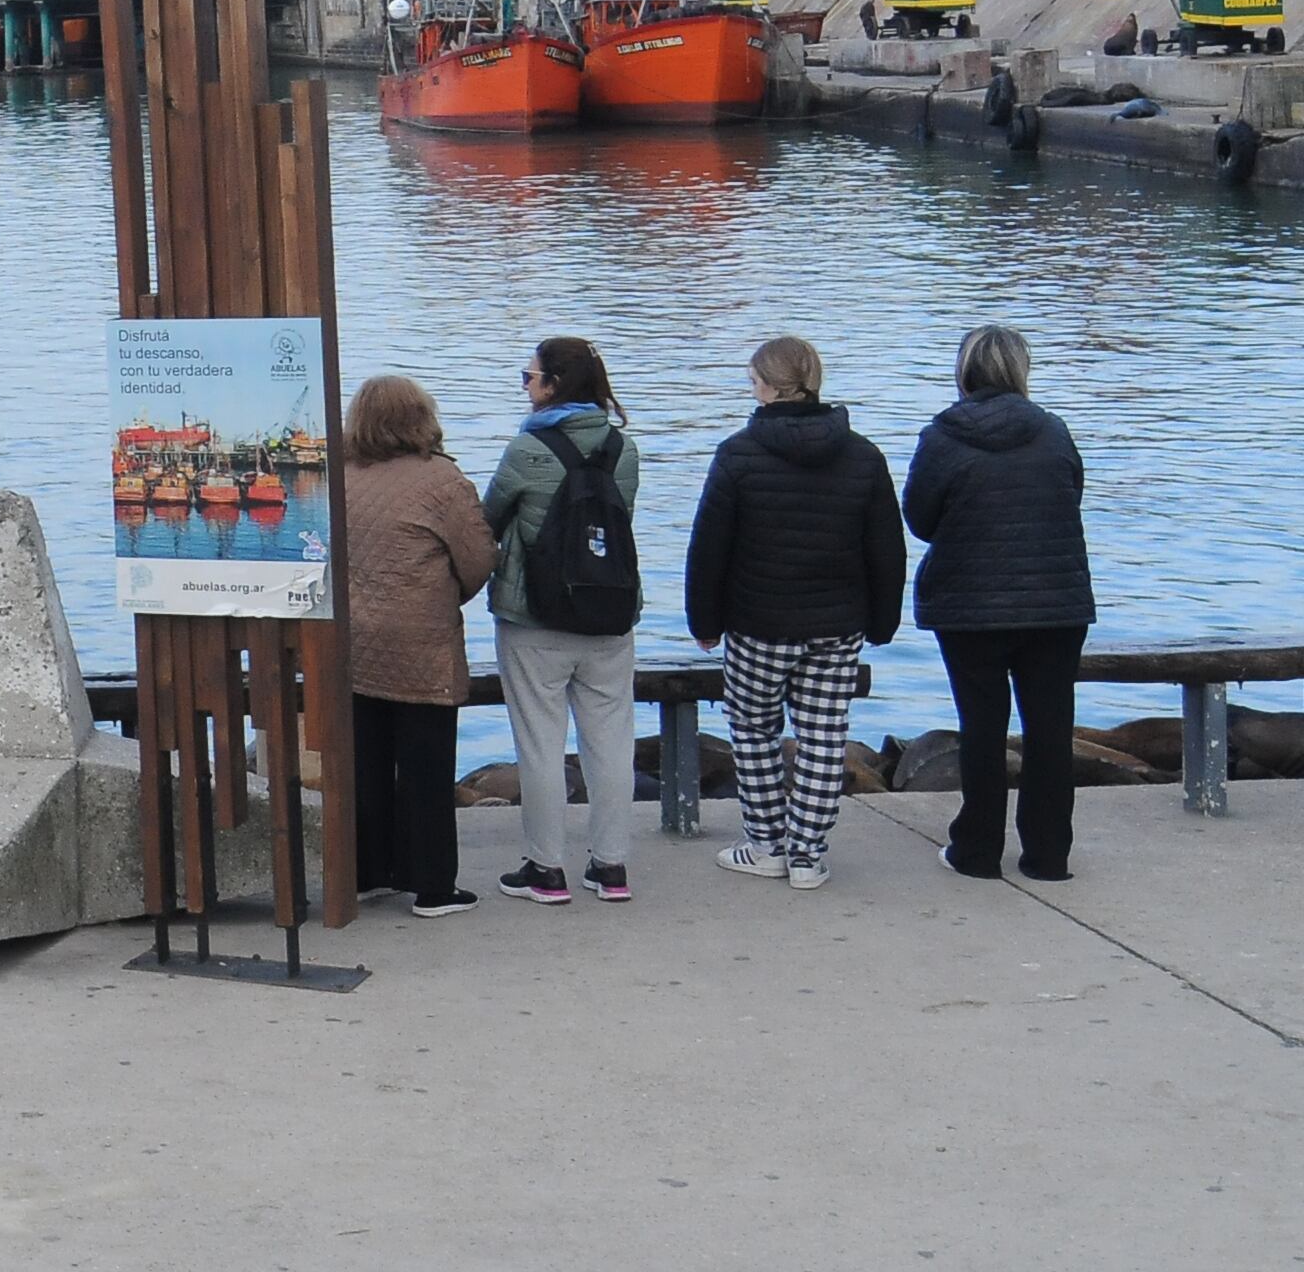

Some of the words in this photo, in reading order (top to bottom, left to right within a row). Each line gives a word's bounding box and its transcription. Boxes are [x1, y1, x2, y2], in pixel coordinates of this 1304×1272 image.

[118, 329, 170, 342] Disfrutá
[119, 348, 132, 360] tu
[135, 347, 204, 361] descanso,
[120, 366, 144, 377] con
[148, 365, 160, 377] tu
[164, 364, 233, 377] verdadera
[270, 364, 307, 372] ABUELAS
[121, 381, 185, 394] identidad.
[182, 581, 265, 595] abuelas.org.ar
